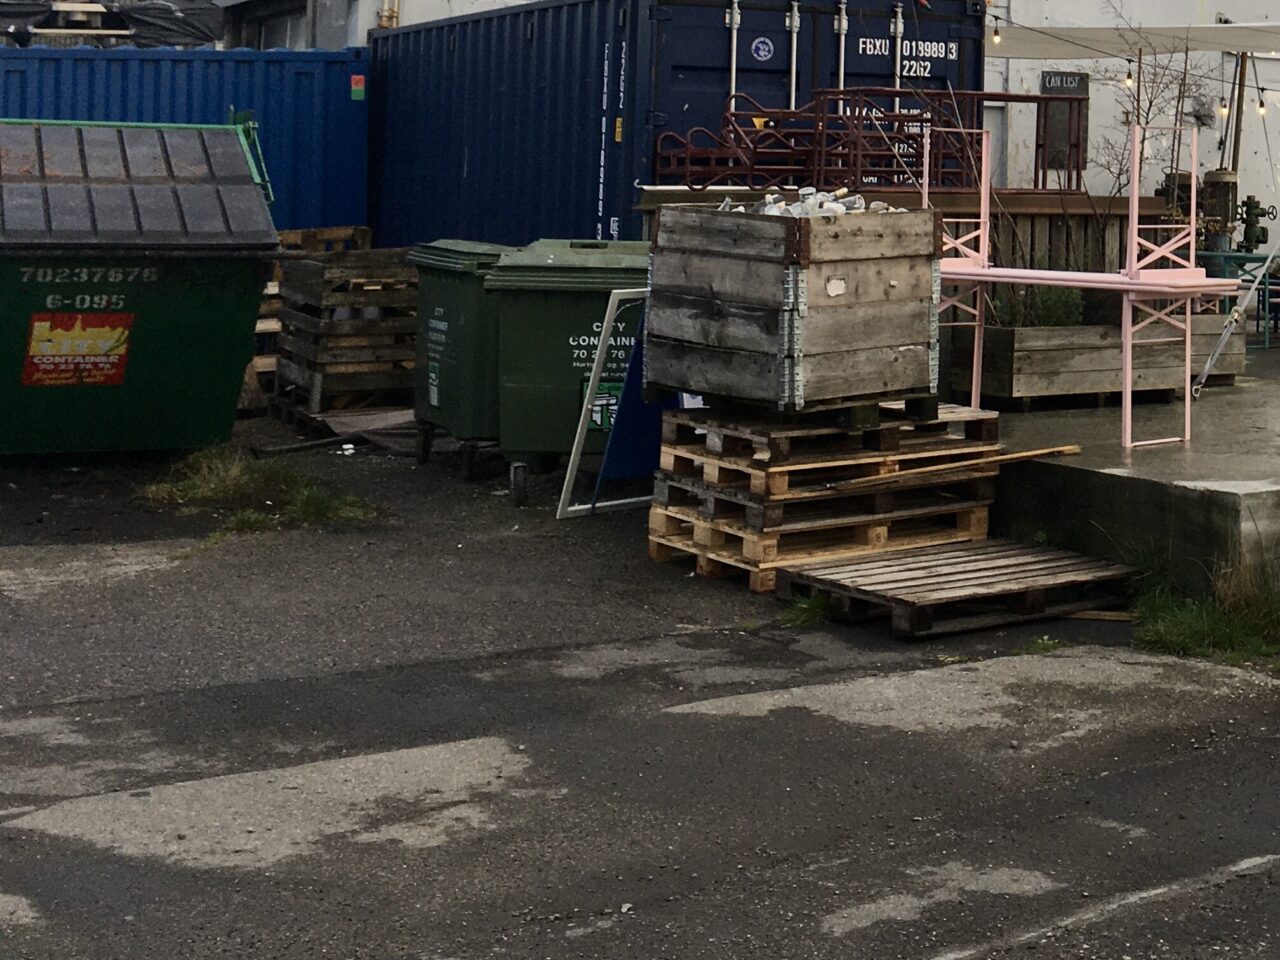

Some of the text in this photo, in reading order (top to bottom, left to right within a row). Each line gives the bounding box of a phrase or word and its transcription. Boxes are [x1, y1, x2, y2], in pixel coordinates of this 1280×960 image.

[858, 37, 958, 60] FBXU 018989 3
[1045, 75, 1080, 88] CAN LIST
[45, 294, 126, 309] 6-095
[592, 322, 626, 332] CY
[569, 336, 637, 346] CONAINE
[572, 350, 588, 359] 70
[611, 350, 626, 359] 76
